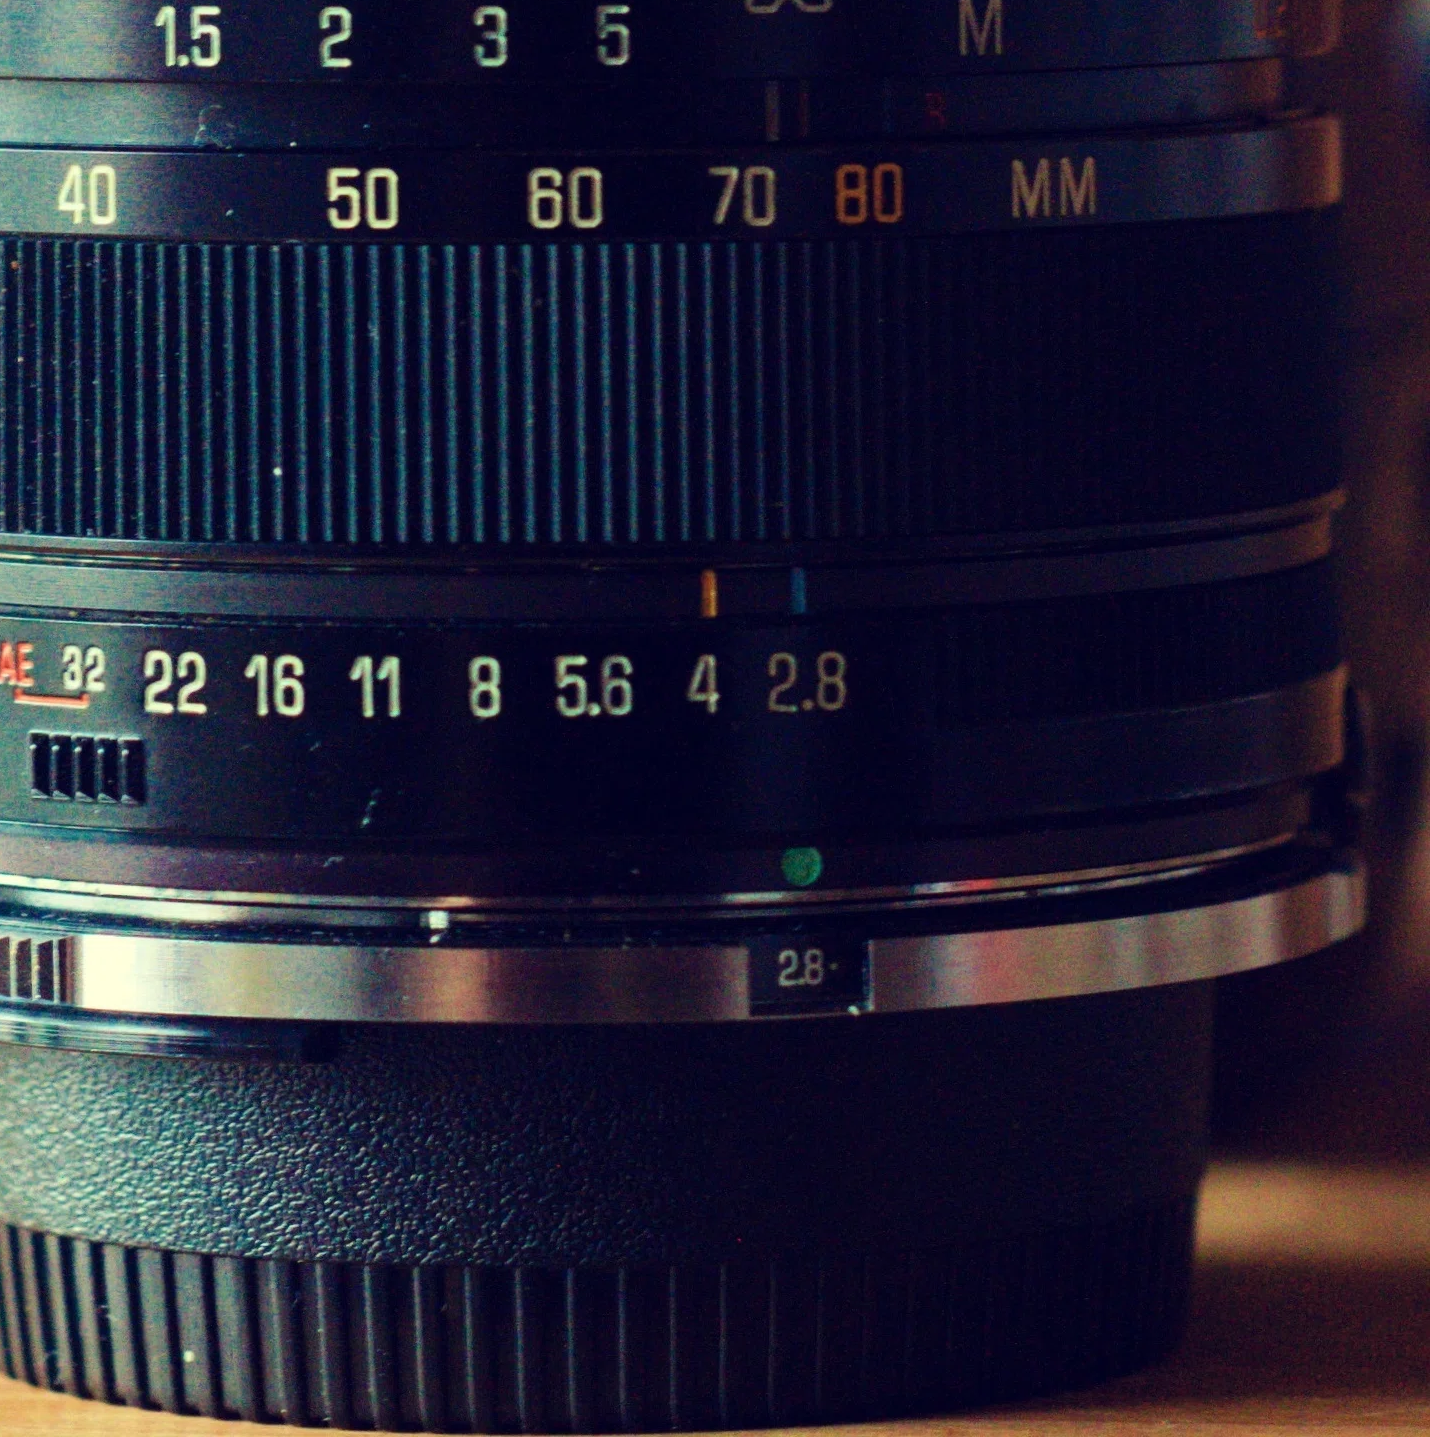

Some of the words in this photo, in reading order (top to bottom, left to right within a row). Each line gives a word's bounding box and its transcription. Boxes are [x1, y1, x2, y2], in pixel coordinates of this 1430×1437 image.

[154, 5, 221, 68] 1.5
[318, 5, 353, 68] 2
[473, 6, 508, 67] 3
[595, 5, 631, 66] 5
[57, 163, 117, 226] 40
[327, 167, 399, 230] 50
[529, 167, 603, 230] 60
[710, 166, 776, 228] 70
[835, 162, 903, 225] 80
[1012, 156, 1096, 217] MM
[62, 645, 106, 693] 32
[143, 650, 207, 715] 22
[244, 654, 305, 717] 16
[350, 655, 401, 718] 11
[470, 656, 501, 718] 8
[556, 654, 633, 718] 5.6
[687, 654, 720, 713] 4
[768, 650, 847, 713] 2.8
